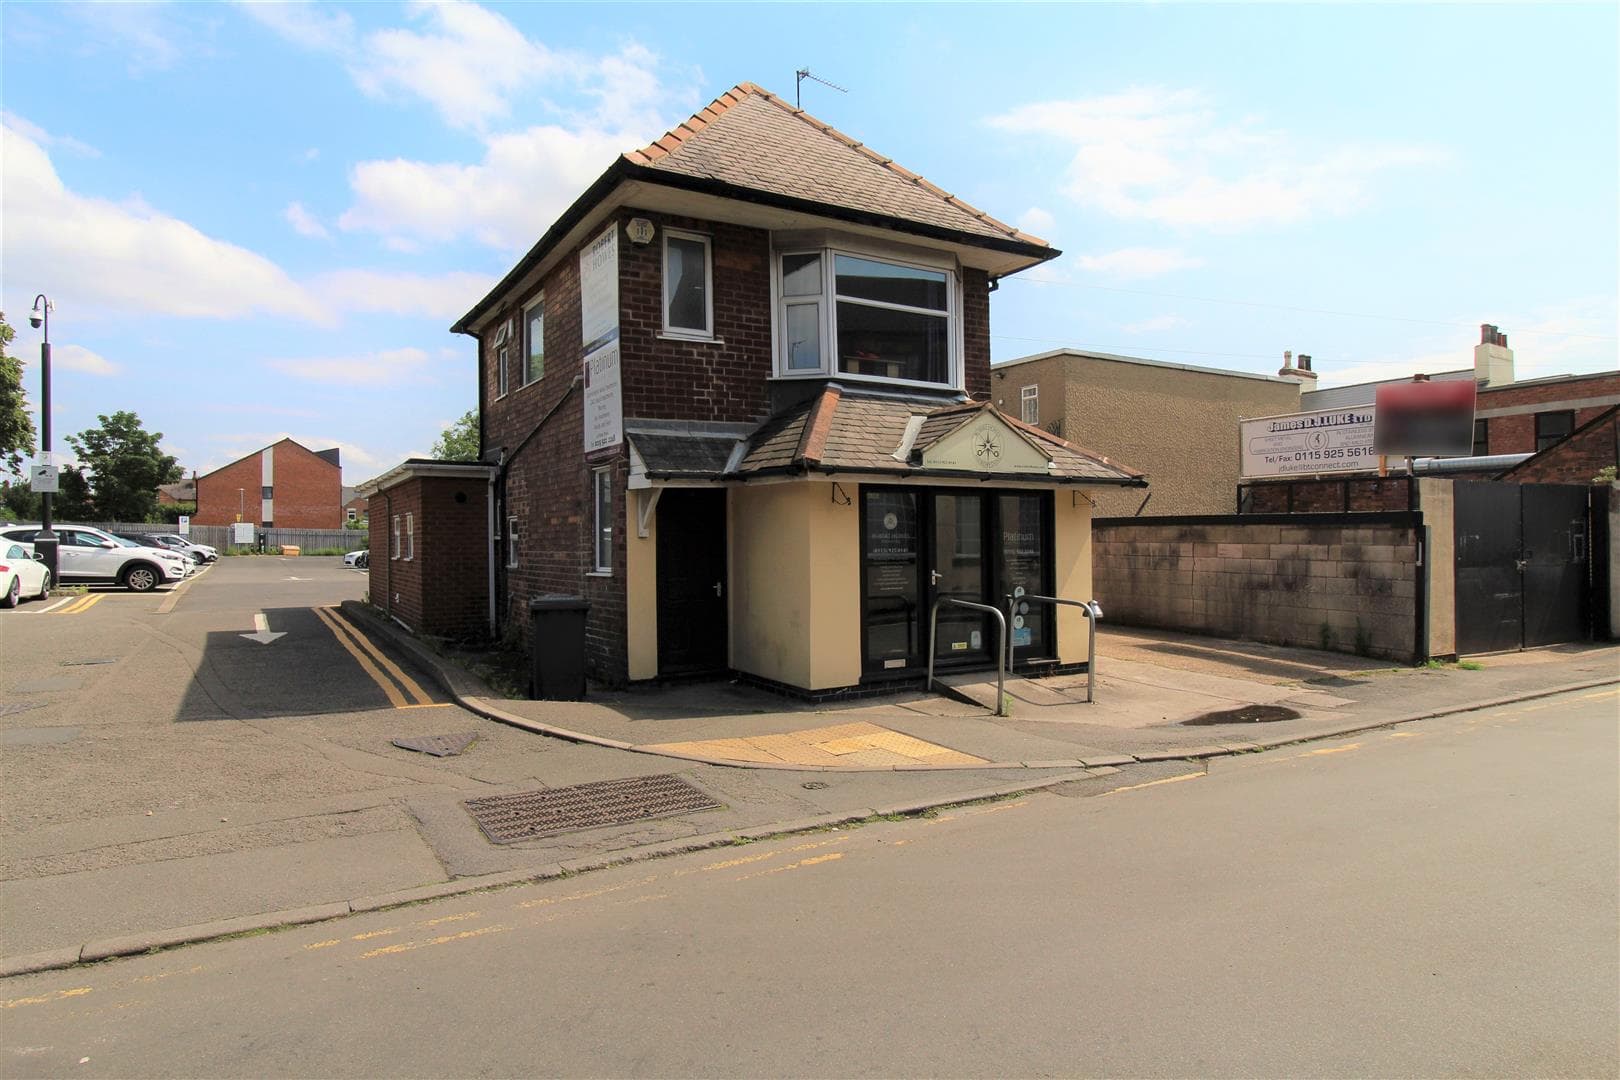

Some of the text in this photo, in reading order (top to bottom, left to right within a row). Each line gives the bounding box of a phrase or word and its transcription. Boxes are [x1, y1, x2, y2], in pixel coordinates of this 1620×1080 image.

[590, 349, 618, 375] Platinum
[1267, 419, 1304, 432] James
[1353, 414, 1373, 425] LTD
[1265, 456, 1293, 464] Tel/Fax:
[1294, 451, 1321, 461] 0115
[1323, 449, 1345, 459] 925
[1003, 531, 1034, 541] Platinum
